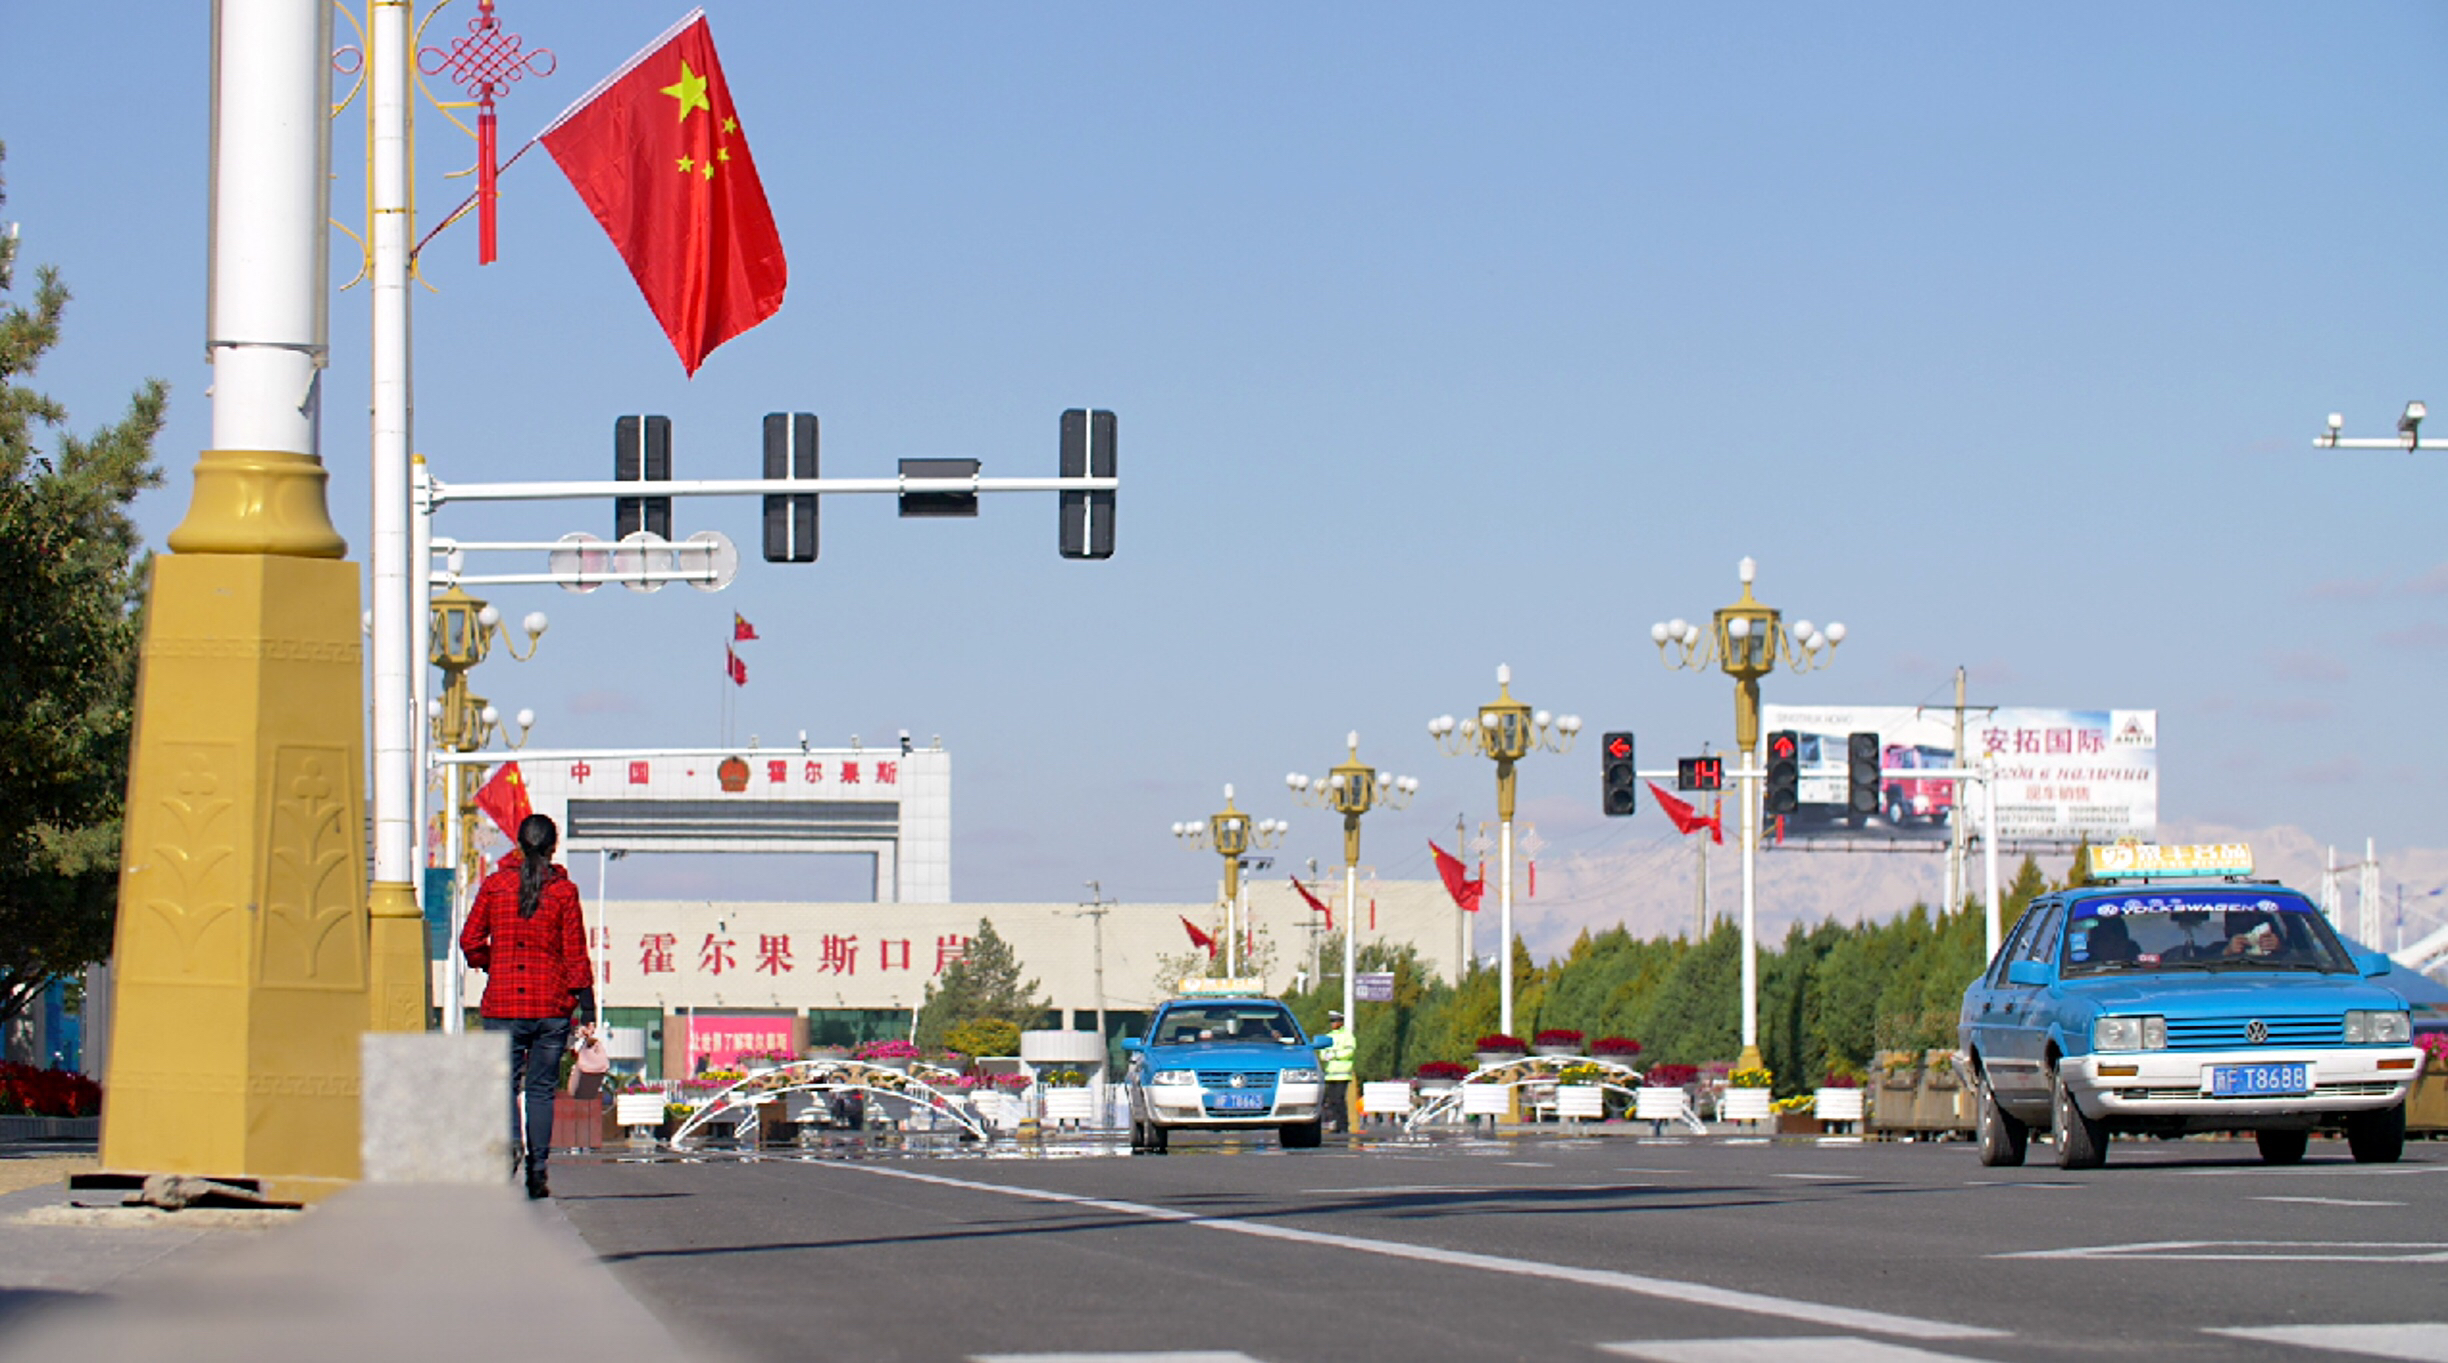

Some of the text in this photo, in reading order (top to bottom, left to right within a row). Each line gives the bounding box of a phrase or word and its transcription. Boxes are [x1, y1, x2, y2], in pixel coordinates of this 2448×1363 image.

[1982, 726, 2105, 754] 安拓国际
[1694, 760, 1719, 788] 14
[2121, 903, 2255, 915] VOLKSWAGEN
[639, 932, 974, 977] 霍尔果斯口岸
